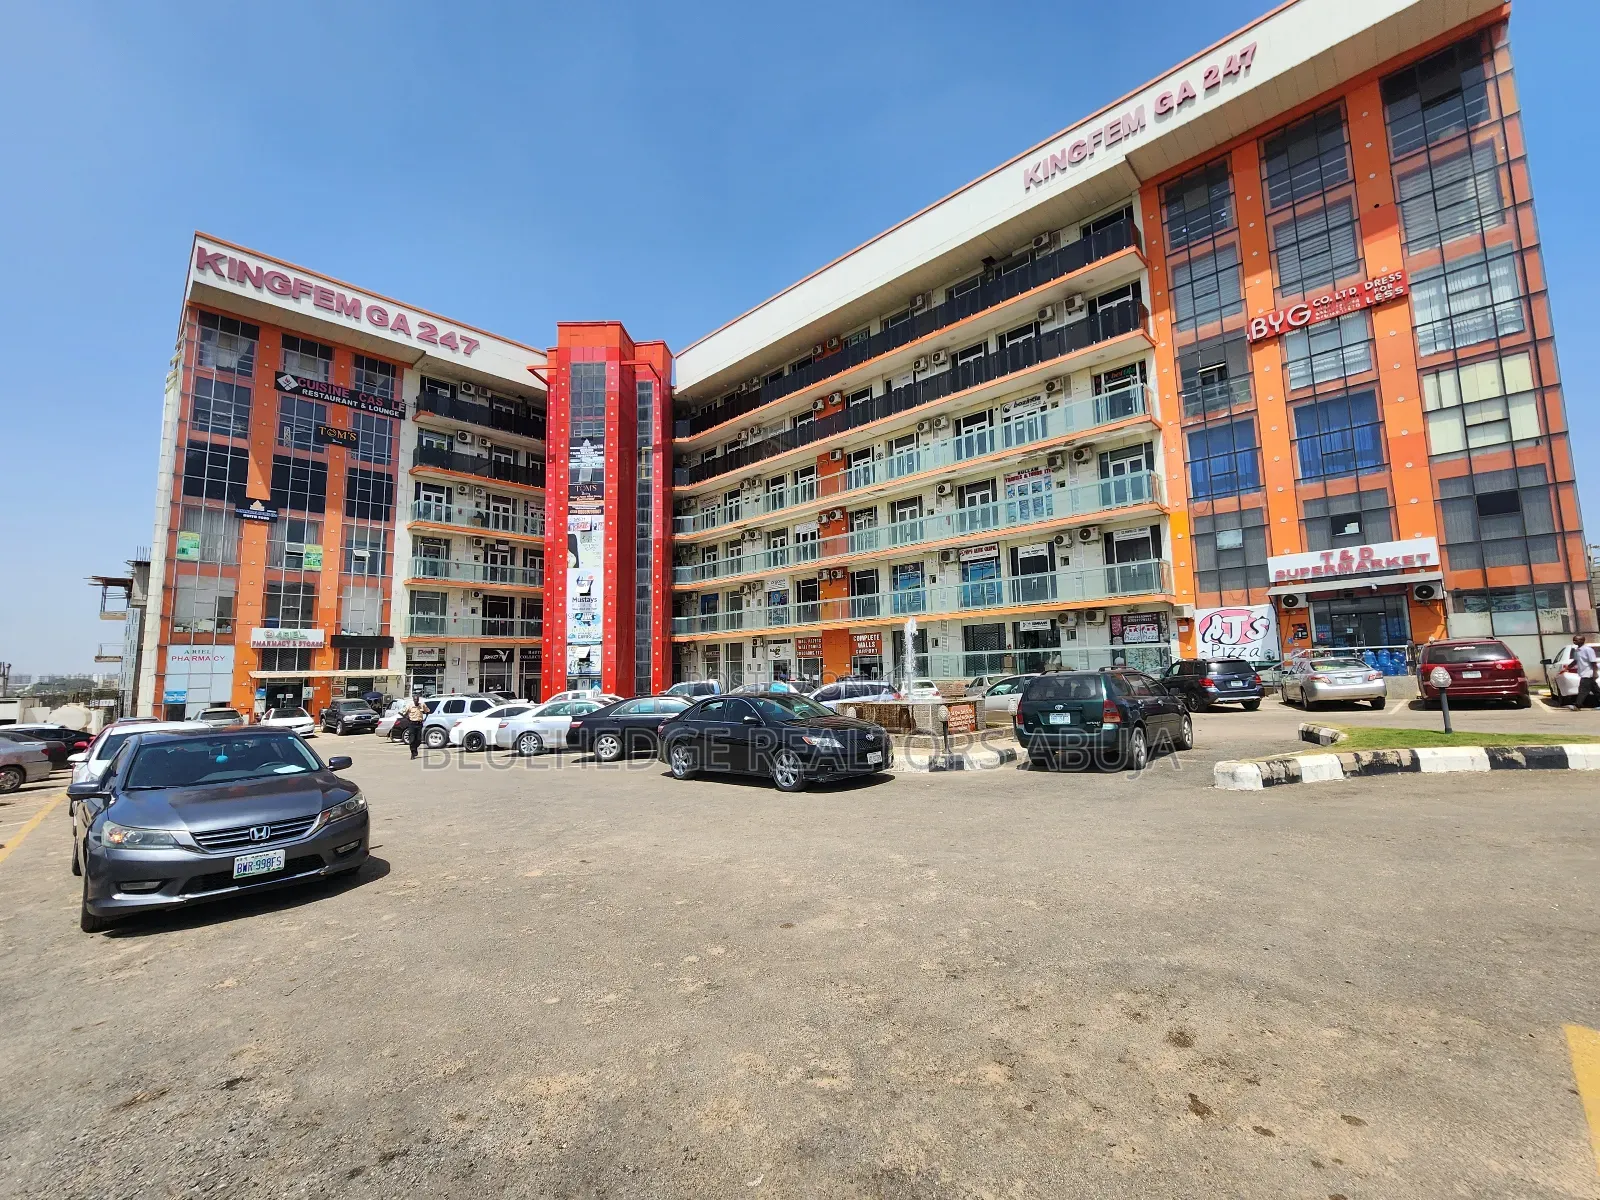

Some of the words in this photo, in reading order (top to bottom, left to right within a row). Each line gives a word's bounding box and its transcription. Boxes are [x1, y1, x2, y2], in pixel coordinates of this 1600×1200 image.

[1024, 104, 1146, 189] KINGFEM
[1154, 80, 1197, 116] GA
[1203, 41, 1258, 90] 247
[1364, 271, 1402, 291] DRESS
[1373, 283, 1393, 295] FOR
[196, 246, 361, 320] KINGFEM
[365, 305, 411, 336] GA
[416, 321, 480, 355] 247
[1366, 286, 1404, 304] LESS
[1251, 303, 1312, 340] BYG
[1335, 287, 1357, 300] LTD
[297, 377, 350, 399] CUISINE
[302, 388, 359, 407] RESTAURANT
[368, 404, 400, 417] LOUNGE
[1275, 552, 1431, 580] SUPERMARKET
[1320, 551, 1333, 565] T
[1340, 549, 1355, 562] &
[1359, 547, 1375, 561] D
[252, 640, 290, 648] PHARMACY
[298, 640, 323, 648] STORES
